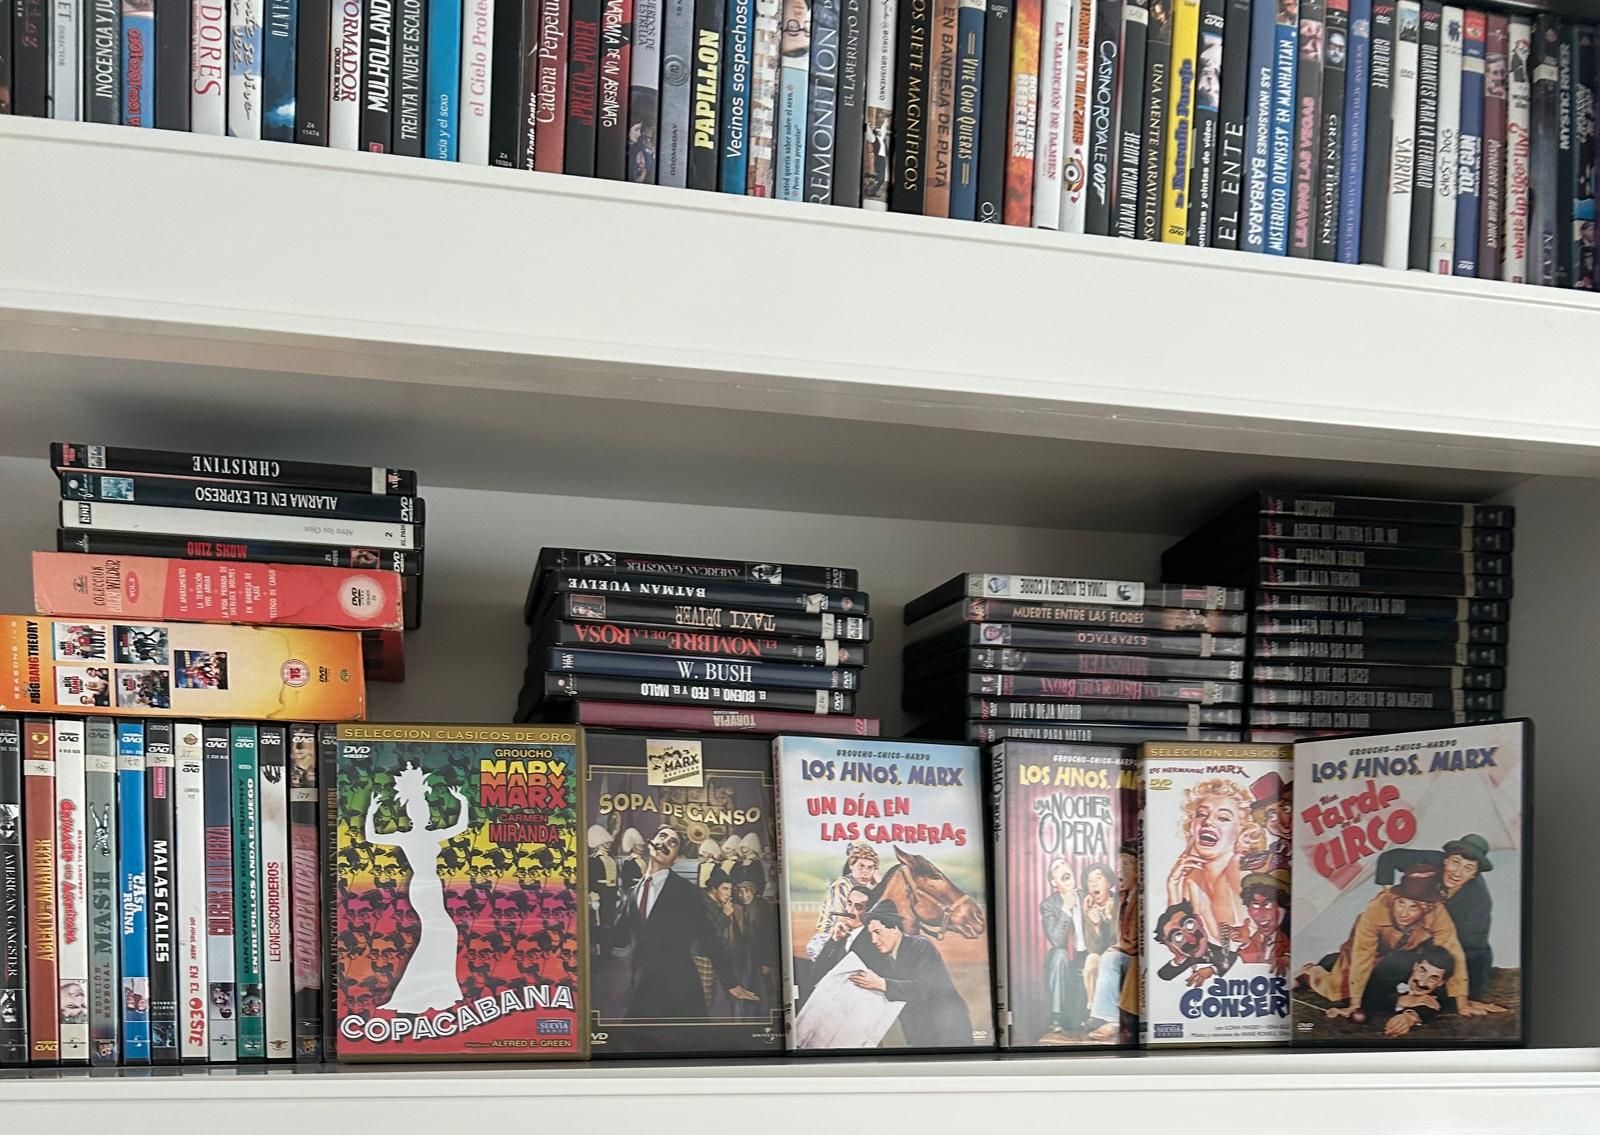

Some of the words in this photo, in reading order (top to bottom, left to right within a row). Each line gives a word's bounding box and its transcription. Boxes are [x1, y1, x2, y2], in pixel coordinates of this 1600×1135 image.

[638, 4, 649, 46] ESTRELLA
[941, 5, 956, 29] EN
[194, 5, 223, 97] DORES
[367, 0, 392, 113] MULHOLLAND
[572, 20, 597, 64] PODER
[843, 16, 860, 92] LABERINTO
[881, 29, 890, 56] BORIS
[908, 25, 925, 72] SIETE
[95, 25, 114, 98] INOCENCIA
[402, 44, 420, 82] NUEVE
[470, 52, 487, 97] Cielo
[879, 56, 889, 101] GRUSHENKO
[938, 31, 954, 109] BANDEJA
[962, 57, 980, 83] VIVE
[1051, 39, 1064, 114] MALDICIÓN
[1098, 39, 1118, 104] CASINO
[1151, 62, 1164, 93] UNA
[1260, 66, 1272, 90] LAS
[1277, 38, 1295, 106] MANHATTAN
[1371, 38, 1392, 89] GOLDENEYE
[1419, 44, 1439, 97] DIAMANTES
[1559, 43, 1571, 91] RIVER
[440, 93, 450, 115] sexo
[536, 66, 557, 123] Cadena
[571, 72, 596, 119] PRECIO
[602, 75, 620, 128] ASESINATO
[693, 28, 720, 150] PAPILLON
[961, 84, 978, 114] COMO
[401, 93, 419, 140] TREINTA
[440, 116, 450, 129] el
[470, 101, 485, 118] el
[529, 92, 538, 124] Center
[938, 111, 951, 134] DE
[1149, 96, 1162, 147] MENTE
[1256, 90, 1271, 155] INVASIONES
[1418, 97, 1437, 122] PARA
[1559, 90, 1571, 150] MYSTIC
[528, 126, 537, 155] Trade
[725, 98, 745, 159] Vecinos
[904, 76, 923, 193] MAGNÍFICOS
[957, 115, 977, 160] QUIERAS
[1025, 103, 1037, 160] POLICIAS
[1091, 104, 1111, 163] ROYALE
[1202, 119, 1213, 148] vídeo
[1326, 113, 1338, 161] GRAN
[438, 138, 450, 161] ucía
[669, 122, 678, 176] DOOMSDAY
[934, 136, 949, 189] PLATA
[1047, 132, 1059, 180] DAMIEN
[1124, 130, 1142, 165] MUERE
[1221, 120, 1245, 196] ENTE
[1271, 126, 1290, 185] ASESINATO
[1391, 136, 1413, 196] SABRINA
[1416, 137, 1436, 189] ETERNIDAD
[1121, 167, 1139, 201] NUNCA
[1144, 148, 1160, 242] MARAVILLOSA
[1201, 166, 1211, 199] cintas
[1438, 159, 1451, 198] GHOST
[1457, 165, 1474, 196] TOP
[1247, 156, 1267, 247] BÁRBARAS
[1268, 188, 1287, 252] MISTERIOSO
[1321, 163, 1337, 245] LEBOWSKI
[1198, 211, 1211, 248] entiras
[1218, 210, 1240, 242] EL
[192, 455, 280, 478] CHRISTINE
[195, 486, 250, 505] EXPRESO
[269, 492, 288, 508] EN
[289, 494, 338, 512] ALARMA
[303, 525, 322, 536] Ojos
[321, 526, 334, 534] los
[335, 527, 354, 536] Abre
[215, 543, 248, 560] SHOW
[626, 561, 683, 575] GANGSTER
[93, 564, 105, 607] COLECCIÓN
[177, 567, 188, 604] APARTAMENTO
[195, 571, 205, 601] TENTACIÓN
[219, 575, 228, 597] PRIVADA
[227, 568, 236, 589] HOLMES
[267, 569, 277, 587] CARGO
[567, 579, 632, 593] VUELVE
[684, 563, 741, 578] AMERICAN
[227, 590, 237, 616] SHERLOCK
[267, 597, 278, 618] TESTIGO
[639, 583, 706, 598] BATMAN
[675, 606, 723, 629] DRIVER
[729, 612, 776, 632] TAXI
[1012, 606, 1052, 620] MUERTE
[1055, 608, 1085, 622] ENTRE
[1088, 610, 1107, 623] LAS
[1110, 611, 1145, 624] FLORES
[574, 624, 633, 646] ROSA
[667, 632, 762, 657] NOMBRE
[1078, 632, 1148, 646] ESPARTACO
[640, 683, 670, 698] MALO
[705, 661, 753, 683] BUSH
[690, 686, 710, 701] FEO
[343, 745, 372, 755] DVD
[344, 728, 430, 740] SELECCION
[435, 730, 511, 742] CLASICOS
[515, 732, 534, 742] DE
[540, 732, 573, 743] ORO
[494, 748, 553, 759] GROUCHO
[1150, 748, 1222, 758] SELECCION
[1225, 749, 1288, 759] CLASICOS
[664, 753, 700, 773] MARX
[801, 758, 837, 782] LOS
[907, 765, 965, 787] MARX
[1019, 763, 1051, 787] LOS
[1162, 766, 1204, 775] HERMANOS
[1206, 764, 1250, 778] MARX
[1311, 759, 1349, 783] LOS
[1429, 746, 1500, 774] MARX
[238, 778, 247, 837] MURPHY
[247, 777, 256, 822] JUEGO
[480, 786, 568, 810] MARX
[599, 792, 658, 816] SOPA
[662, 801, 684, 818] DE
[685, 802, 762, 826] GANSO
[806, 796, 838, 817] UN
[842, 792, 881, 819] DÍA
[883, 796, 911, 818] EN
[1050, 791, 1103, 820] NOCHE
[1300, 779, 1400, 837] Tarde
[488, 824, 559, 844] MIRANDA
[499, 813, 549, 824] CARMEN
[820, 821, 861, 842] LAS
[864, 822, 968, 847] CARRERAS
[1038, 812, 1109, 857] OPERA
[239, 840, 248, 878] EDDIE
[249, 840, 257, 880] ANDA
[1312, 807, 1418, 880] CIRCO
[4, 851, 17, 910] AMERICAN
[151, 839, 169, 899] MALAS
[250, 880, 258, 929] PILLOS
[266, 861, 281, 919] CORDEROS
[124, 892, 135, 936] RUINA
[240, 880, 250, 946] AYKROYD
[6, 915, 19, 977] GANGSTER
[155, 901, 171, 963] CALLES
[268, 921, 282, 963] LEONES
[251, 931, 259, 975] ENTRE
[103, 962, 111, 1020] ESPECIAL
[1179, 986, 1290, 1020] CONSER
[188, 996, 205, 1047] OESTE
[339, 984, 577, 1042] COPACABANA
[538, 1021, 570, 1030] SUEVIA
[491, 1039, 528, 1048] ALFRED
[539, 1039, 572, 1048] GREEN
